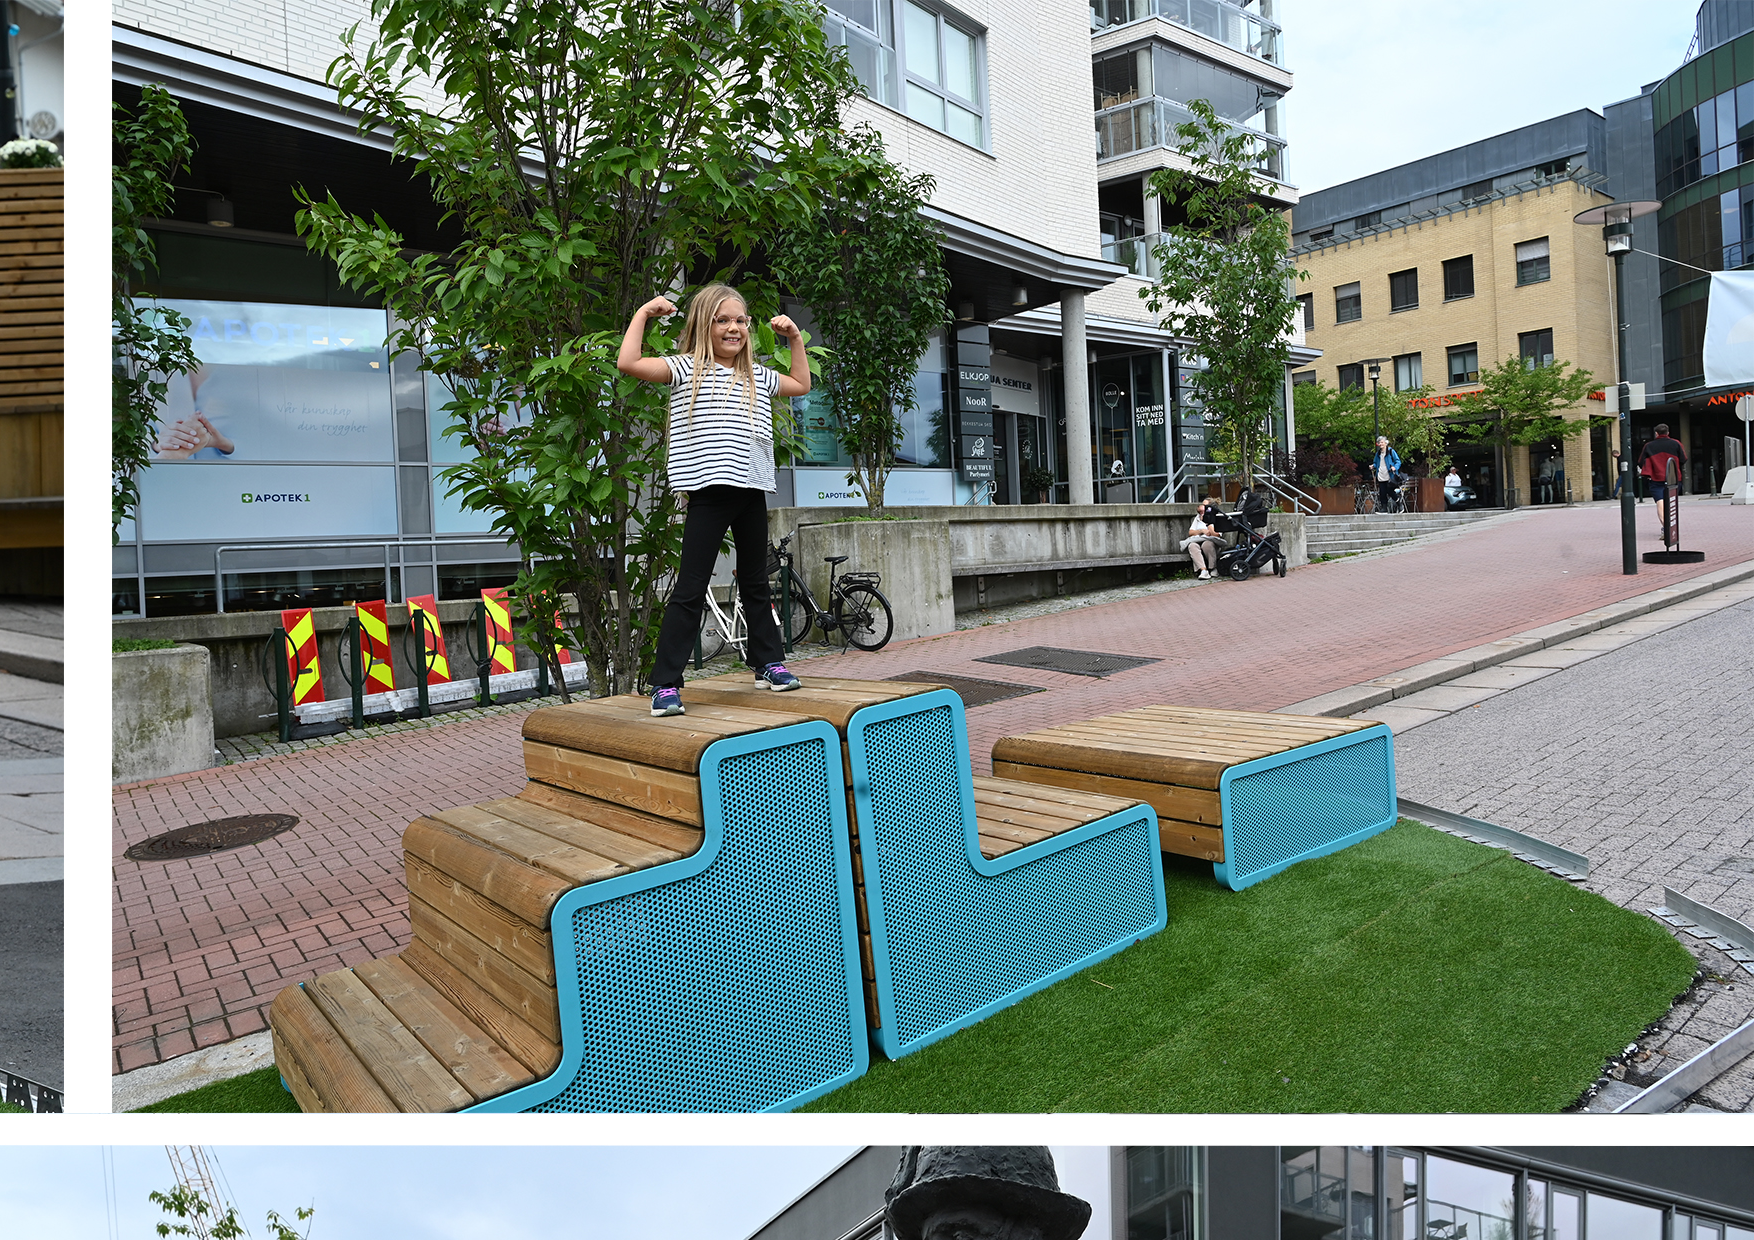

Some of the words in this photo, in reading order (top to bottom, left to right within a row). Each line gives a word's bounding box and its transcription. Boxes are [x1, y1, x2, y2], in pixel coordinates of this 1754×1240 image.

[1002, 377, 1032, 391] SENTER
[1150, 411, 1164, 419] NED
[1147, 418, 1164, 426] MED
[254, 493, 303, 503] APOTEK
[304, 493, 311, 502] 1
